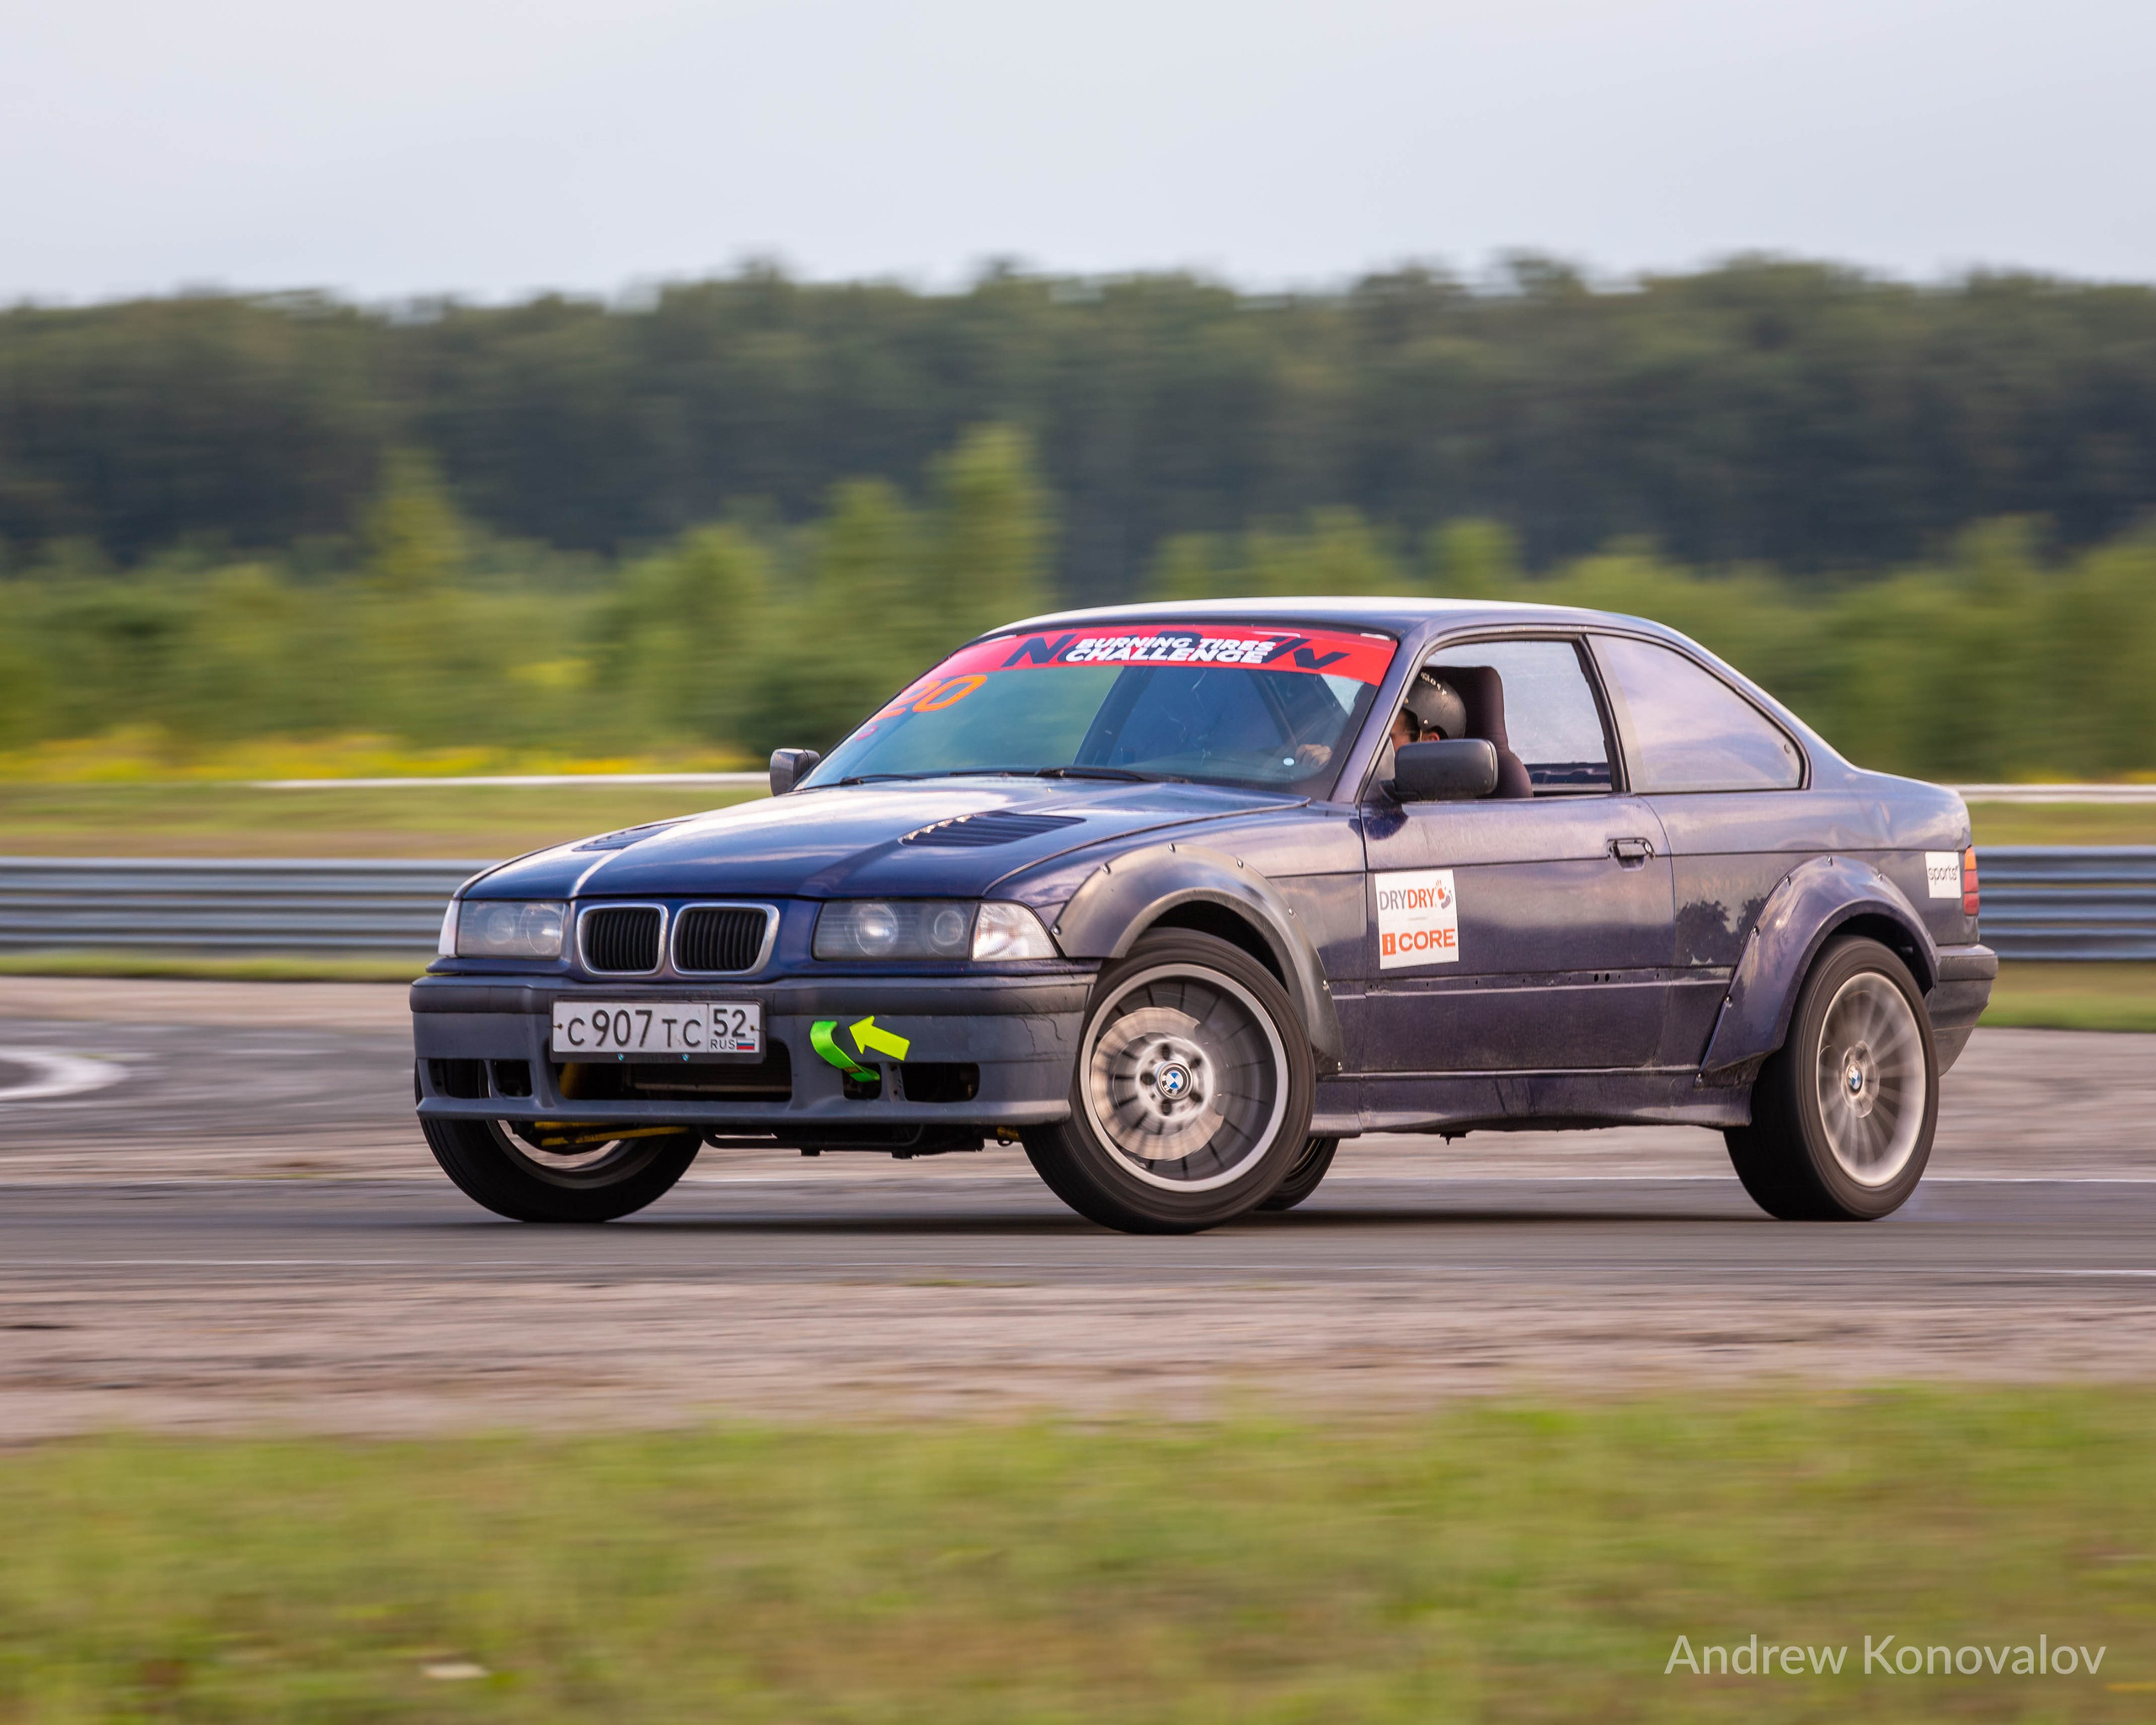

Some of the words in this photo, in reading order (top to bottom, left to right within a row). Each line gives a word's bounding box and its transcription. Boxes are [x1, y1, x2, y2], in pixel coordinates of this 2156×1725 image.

[1075, 637, 1193, 649] BURNING
[1198, 638, 1276, 652] TIRES
[1065, 647, 1268, 665] CHALLENGE
[868, 675, 988, 724] 20
[1379, 888, 1435, 911] DRYDRY
[713, 1008, 747, 1038] 52
[710, 1039, 736, 1050] RUS
